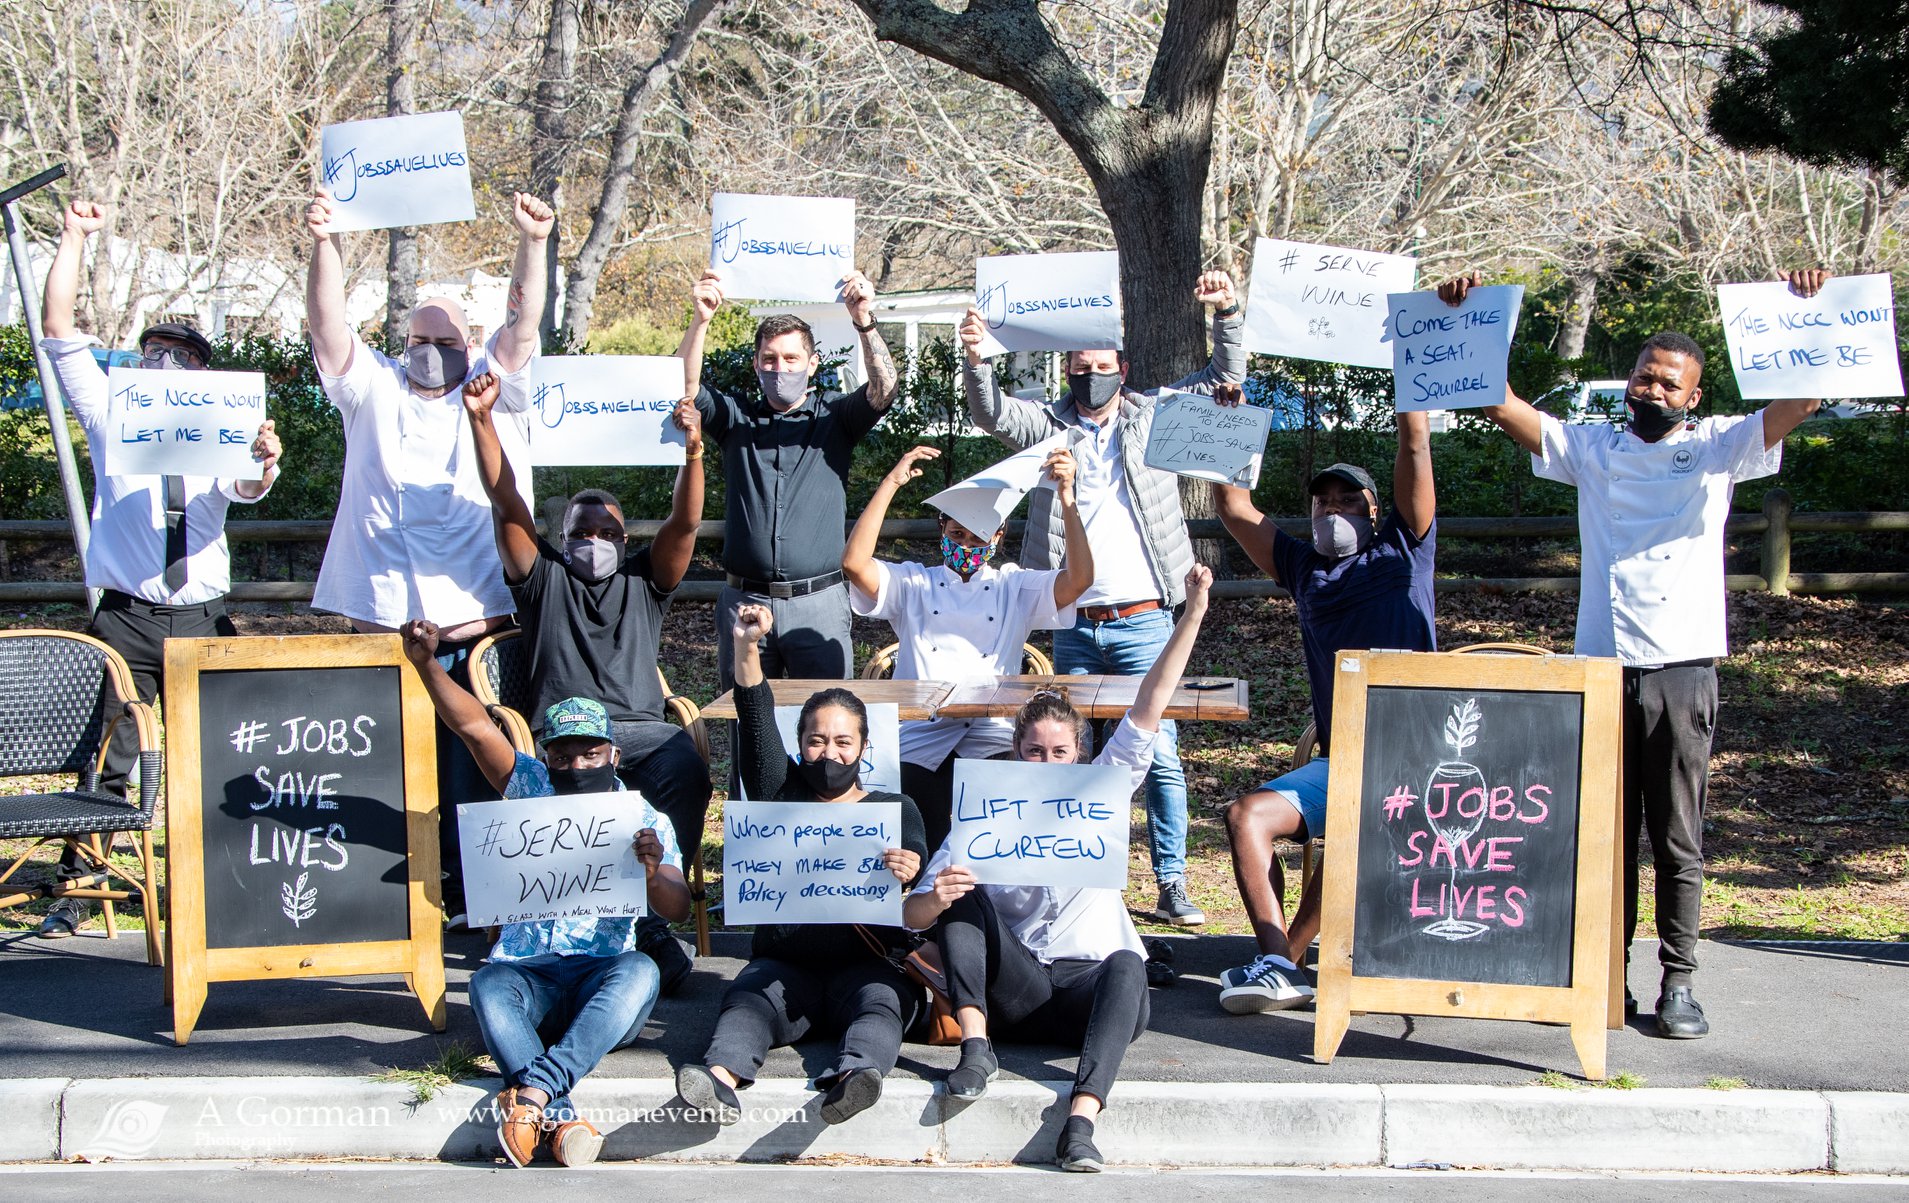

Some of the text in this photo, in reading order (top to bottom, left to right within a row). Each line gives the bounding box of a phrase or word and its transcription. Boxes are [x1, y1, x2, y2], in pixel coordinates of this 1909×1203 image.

[1301, 283, 1375, 308] WINE
[1395, 309, 1501, 338] COME TAKE
[1729, 307, 1770, 338] THE
[1778, 311, 1832, 331] NCCC
[1405, 347, 1415, 366] A
[1739, 345, 1873, 371] LET ME BE
[115, 383, 154, 411] THE
[165, 388, 215, 407] NCCC
[1413, 371, 1489, 402] SQUIRREL
[121, 423, 247, 444] LET ME BE
[1216, 421, 1242, 431] EAT
[249, 765, 343, 811] SAVE
[957, 781, 1115, 822] LIFT THE
[729, 814, 786, 840] When
[793, 823, 845, 848] people
[967, 832, 1106, 860] CURFEW
[249, 822, 349, 872] LIVES
[1398, 830, 1525, 872] SAVE
[731, 859, 782, 876] THEY
[795, 857, 847, 875] MAKE
[518, 863, 615, 904] WINE
[738, 878, 788, 913] Policy
[492, 914, 499, 925] A
[538, 910, 558, 920] WITH
[1409, 877, 1527, 928] LIVES
